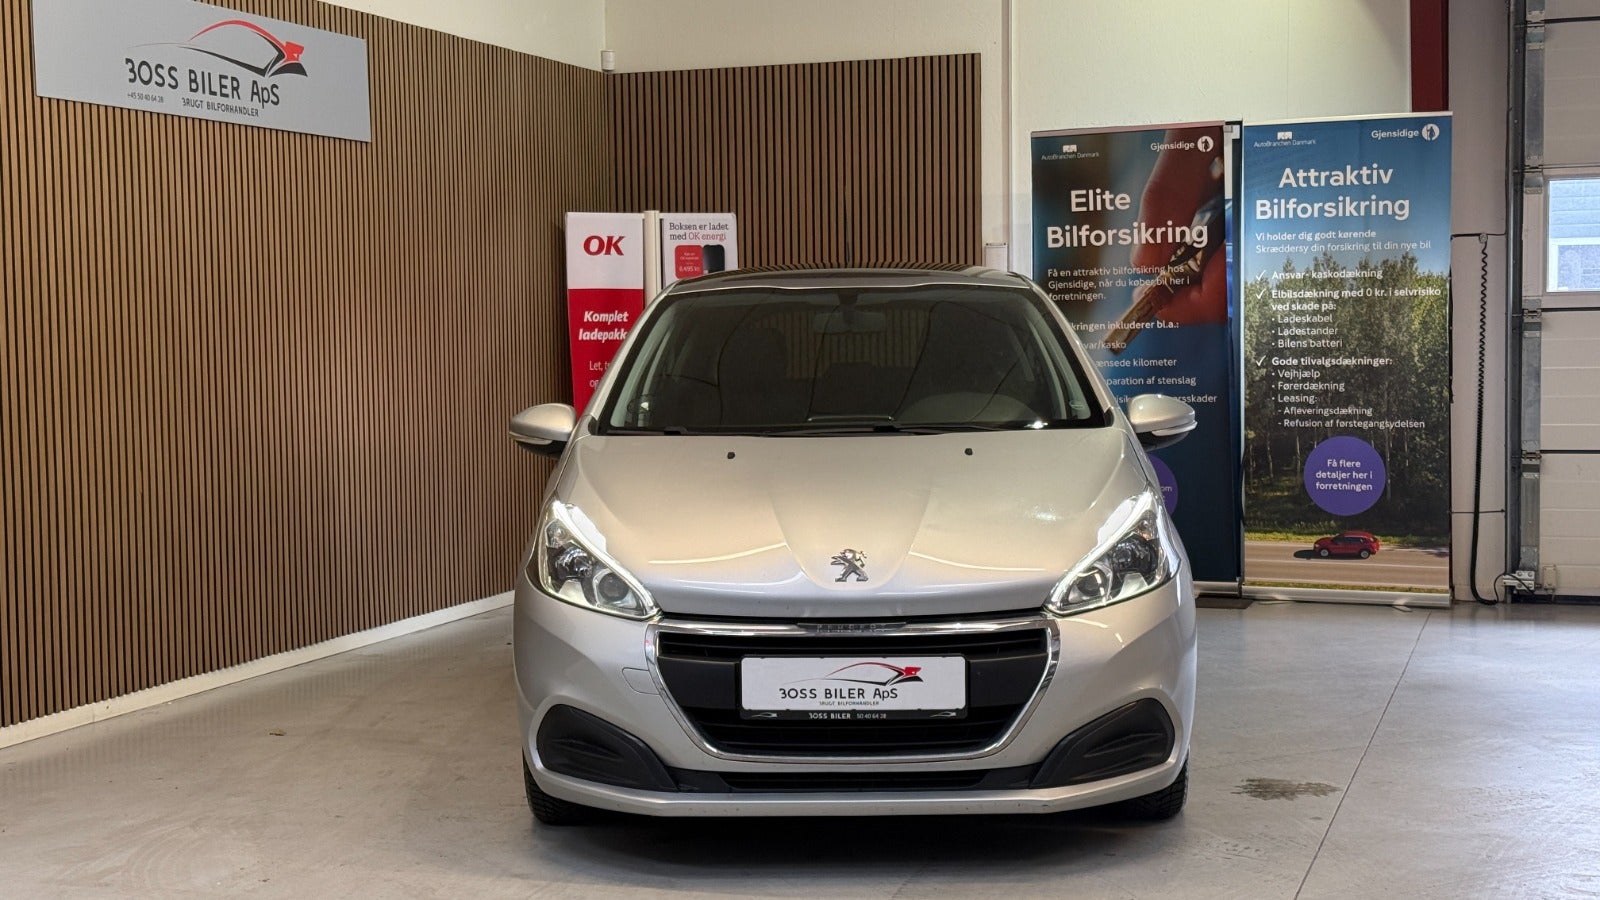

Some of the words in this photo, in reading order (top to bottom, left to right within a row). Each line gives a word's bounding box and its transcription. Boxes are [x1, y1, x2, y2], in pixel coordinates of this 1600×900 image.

[125, 57, 179, 90] BOSS
[189, 69, 241, 100] BILER
[251, 80, 280, 109] ApS
[206, 101, 259, 117] BILFORHANDLER
[1372, 129, 1420, 140] Gjensidige
[1150, 142, 1196, 152] Gjensidige
[1278, 163, 1394, 188] Attraktiv
[1070, 188, 1132, 212] Elite
[1256, 194, 1410, 221] Bilforsikring
[669, 222, 698, 230] Boksen
[709, 222, 729, 230] ladet
[670, 232, 686, 240] med
[688, 232, 700, 240] OK
[702, 232, 726, 242] energi
[1046, 220, 1208, 248] Bilforsikring
[1256, 232, 1266, 241] Vi
[1266, 231, 1296, 240] holder
[1298, 231, 1313, 242] dig
[1314, 231, 1336, 242] godt
[1338, 230, 1376, 239] kørende
[583, 235, 626, 256] OK
[1256, 244, 1308, 255] Skræddersy
[1310, 243, 1326, 252] din
[1327, 242, 1370, 253] forsikring
[1372, 241, 1382, 250] til
[1384, 241, 1398, 250] din
[1400, 242, 1418, 252] nye
[1419, 240, 1432, 249] bil
[1048, 268, 1058, 278] Få
[1072, 267, 1111, 277] attraktiv
[1112, 265, 1166, 276] bilforsikring
[1168, 264, 1184, 274] hos
[1272, 270, 1308, 280] Ansvar-
[1311, 269, 1384, 280] kaskodækning
[1048, 280, 1097, 291] Gjensidige,
[1098, 278, 1114, 288] når
[1115, 278, 1127, 288] du
[1128, 278, 1156, 288] køber
[1157, 276, 1168, 286] bil
[1170, 276, 1184, 286] her
[1048, 292, 1106, 302] forretningen.
[1272, 289, 1340, 300] Elbilsdækning
[1342, 289, 1364, 298] med
[1366, 288, 1373, 297] 0
[1374, 288, 1388, 297] kr.
[1394, 288, 1441, 297] selvrisiko
[1272, 302, 1290, 311] ved
[1292, 302, 1320, 311] skade
[1322, 302, 1337, 312] på:
[584, 310, 629, 325] Komplet
[1278, 314, 1333, 324] Ladeskabel
[1071, 322, 1106, 332] kringen
[1108, 321, 1154, 330] inkluderer
[1278, 326, 1338, 336] Ladestander
[578, 328, 628, 343] ladepakk
[1278, 338, 1308, 348] Bilens
[1310, 338, 1343, 348] batteri
[1095, 359, 1132, 368] ænsede
[1132, 358, 1178, 368] kilometer
[1272, 356, 1299, 366] Gode
[1301, 356, 1392, 368] tilvalgsdækninger:
[1278, 370, 1321, 380] Vejhjælp
[1105, 377, 1144, 386] paration
[1146, 376, 1156, 385] af
[1157, 376, 1197, 386] stenslag
[1278, 381, 1346, 392] Førerdækning
[1278, 394, 1318, 404] Leasing:
[1284, 406, 1373, 416] Afleveringsdækning
[1284, 418, 1324, 428] Refusion
[1325, 418, 1335, 428] af
[1336, 418, 1426, 430] førstegangsydelsen
[1327, 458, 1338, 468] Få
[1339, 458, 1361, 468] flere
[1315, 470, 1351, 480] detaljer
[1352, 470, 1369, 480] her
[1315, 481, 1373, 492] forretningen
[824, 688, 866, 700] BILER
[873, 688, 898, 701] ApS
